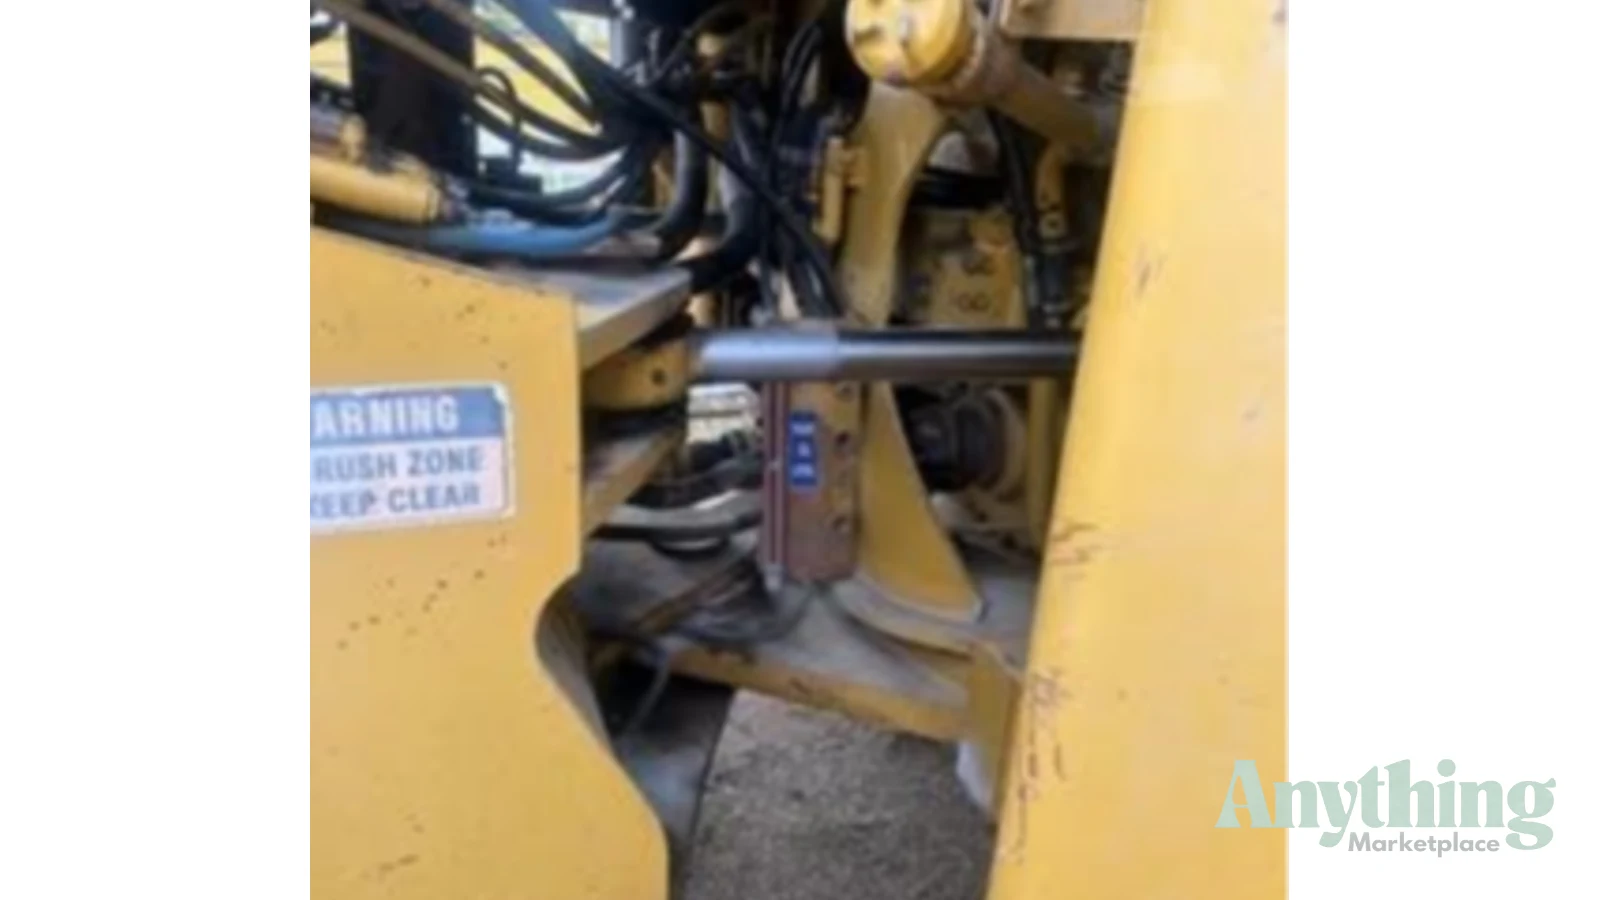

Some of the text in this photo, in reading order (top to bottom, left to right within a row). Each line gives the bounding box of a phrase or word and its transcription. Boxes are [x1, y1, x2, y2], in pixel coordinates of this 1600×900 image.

[312, 395, 458, 438] ARNING
[314, 446, 484, 482] RUSH ZONE
[387, 483, 480, 512] CLEAR
